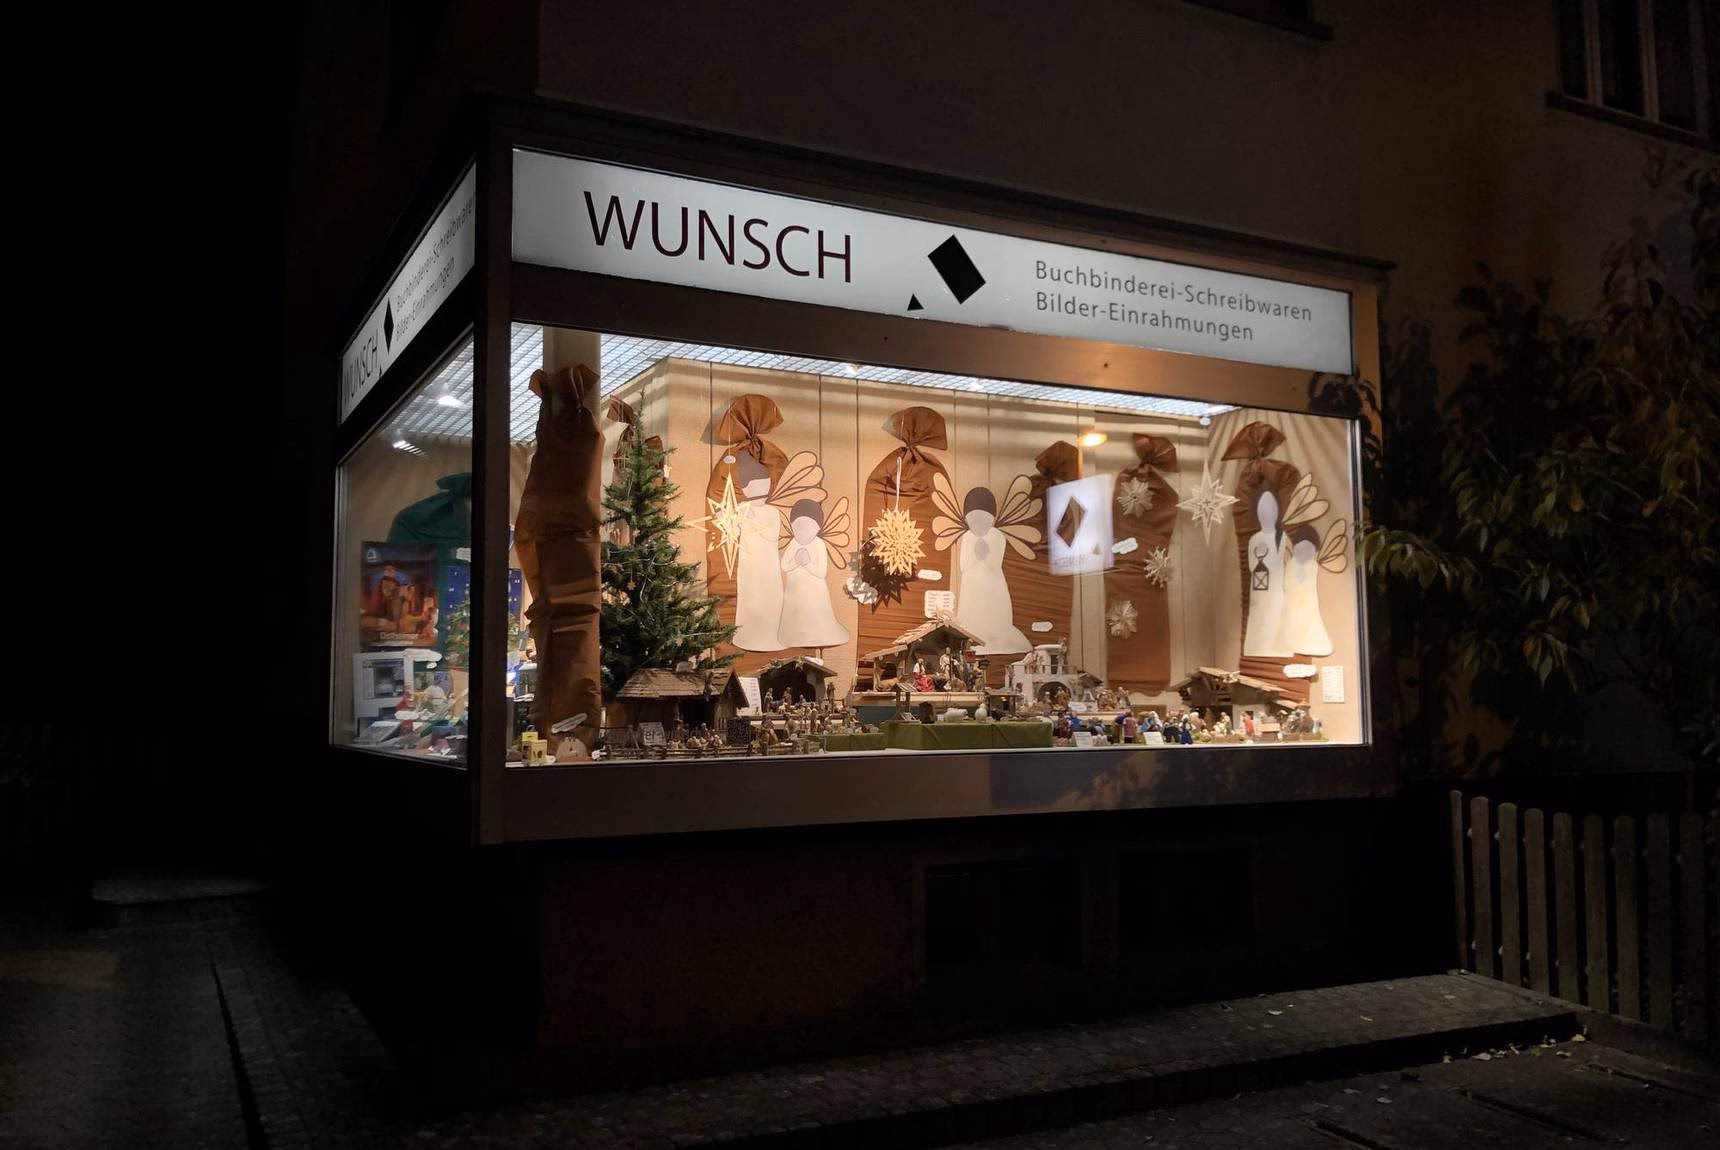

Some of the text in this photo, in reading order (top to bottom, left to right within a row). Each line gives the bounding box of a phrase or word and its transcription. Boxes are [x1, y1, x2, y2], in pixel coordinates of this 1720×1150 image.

[396, 196, 475, 312] Buchbinderei-Schreibware
[583, 191, 851, 283] WUNSCH
[1036, 260, 1312, 321] Buchbinderei-Schreibwaren
[1036, 291, 1254, 341] Bilder-Einrahmungen
